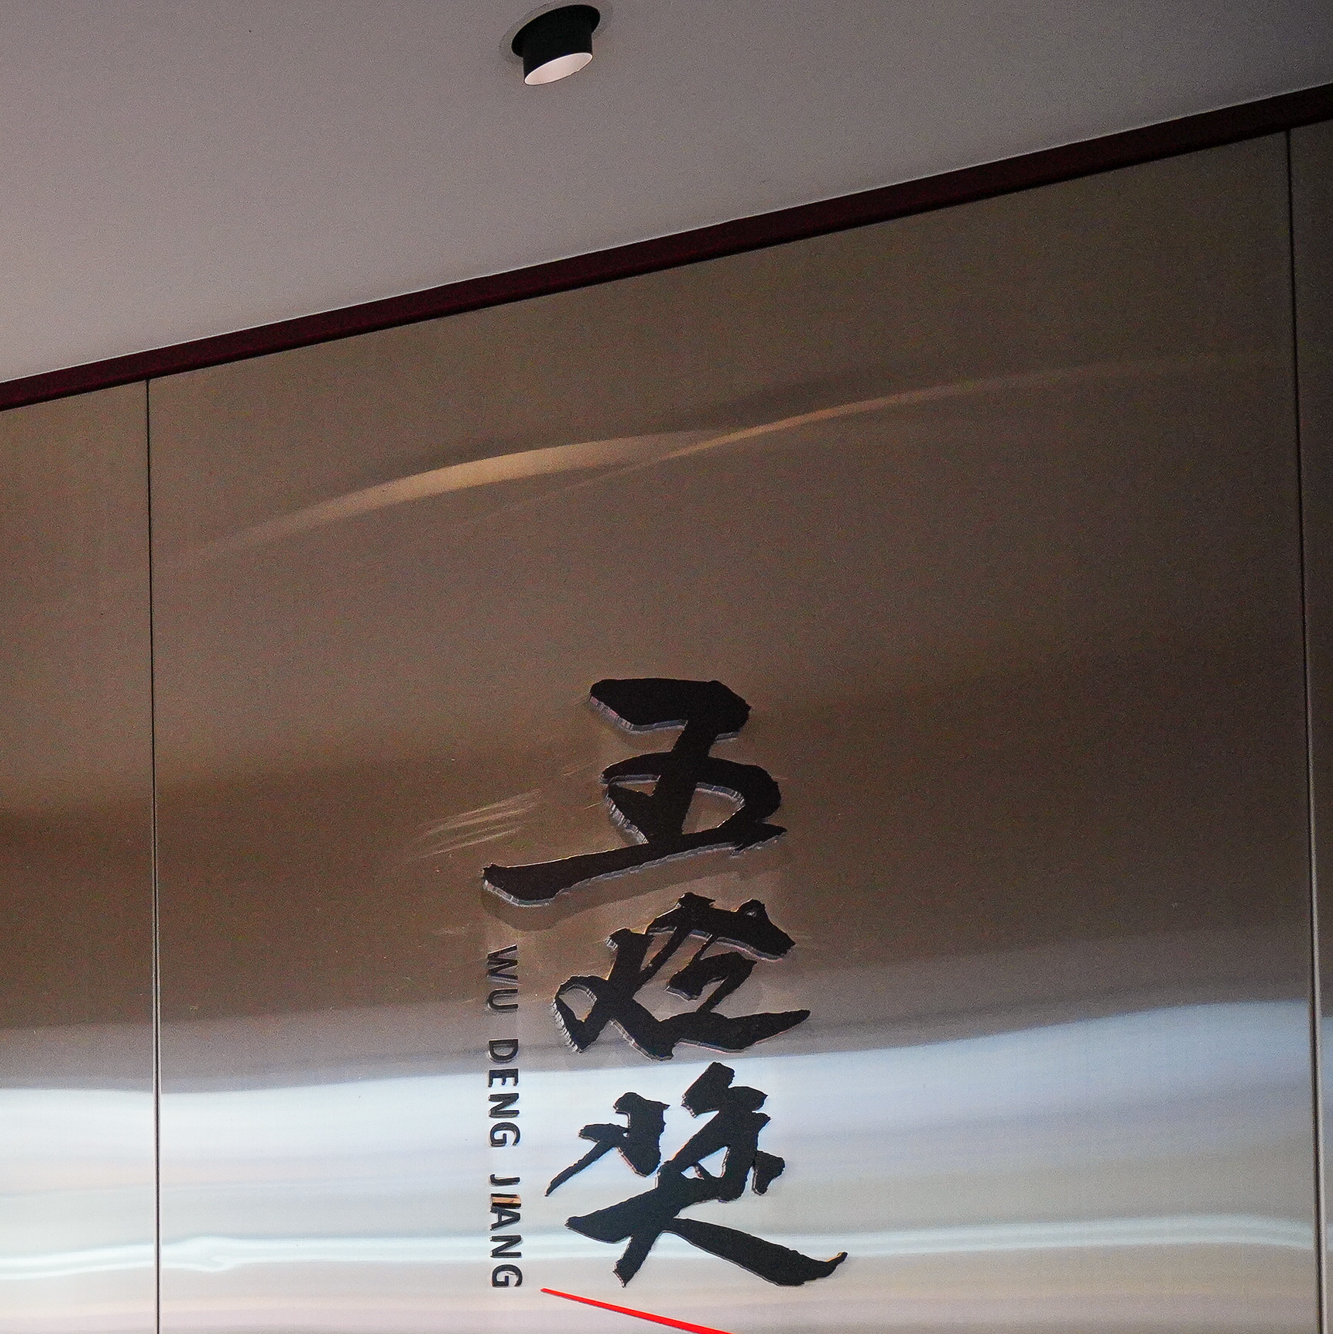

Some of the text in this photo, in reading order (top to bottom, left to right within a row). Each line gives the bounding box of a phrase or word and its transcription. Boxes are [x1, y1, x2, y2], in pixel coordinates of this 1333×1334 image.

[486, 944, 523, 1289] WU DENG JIANG
